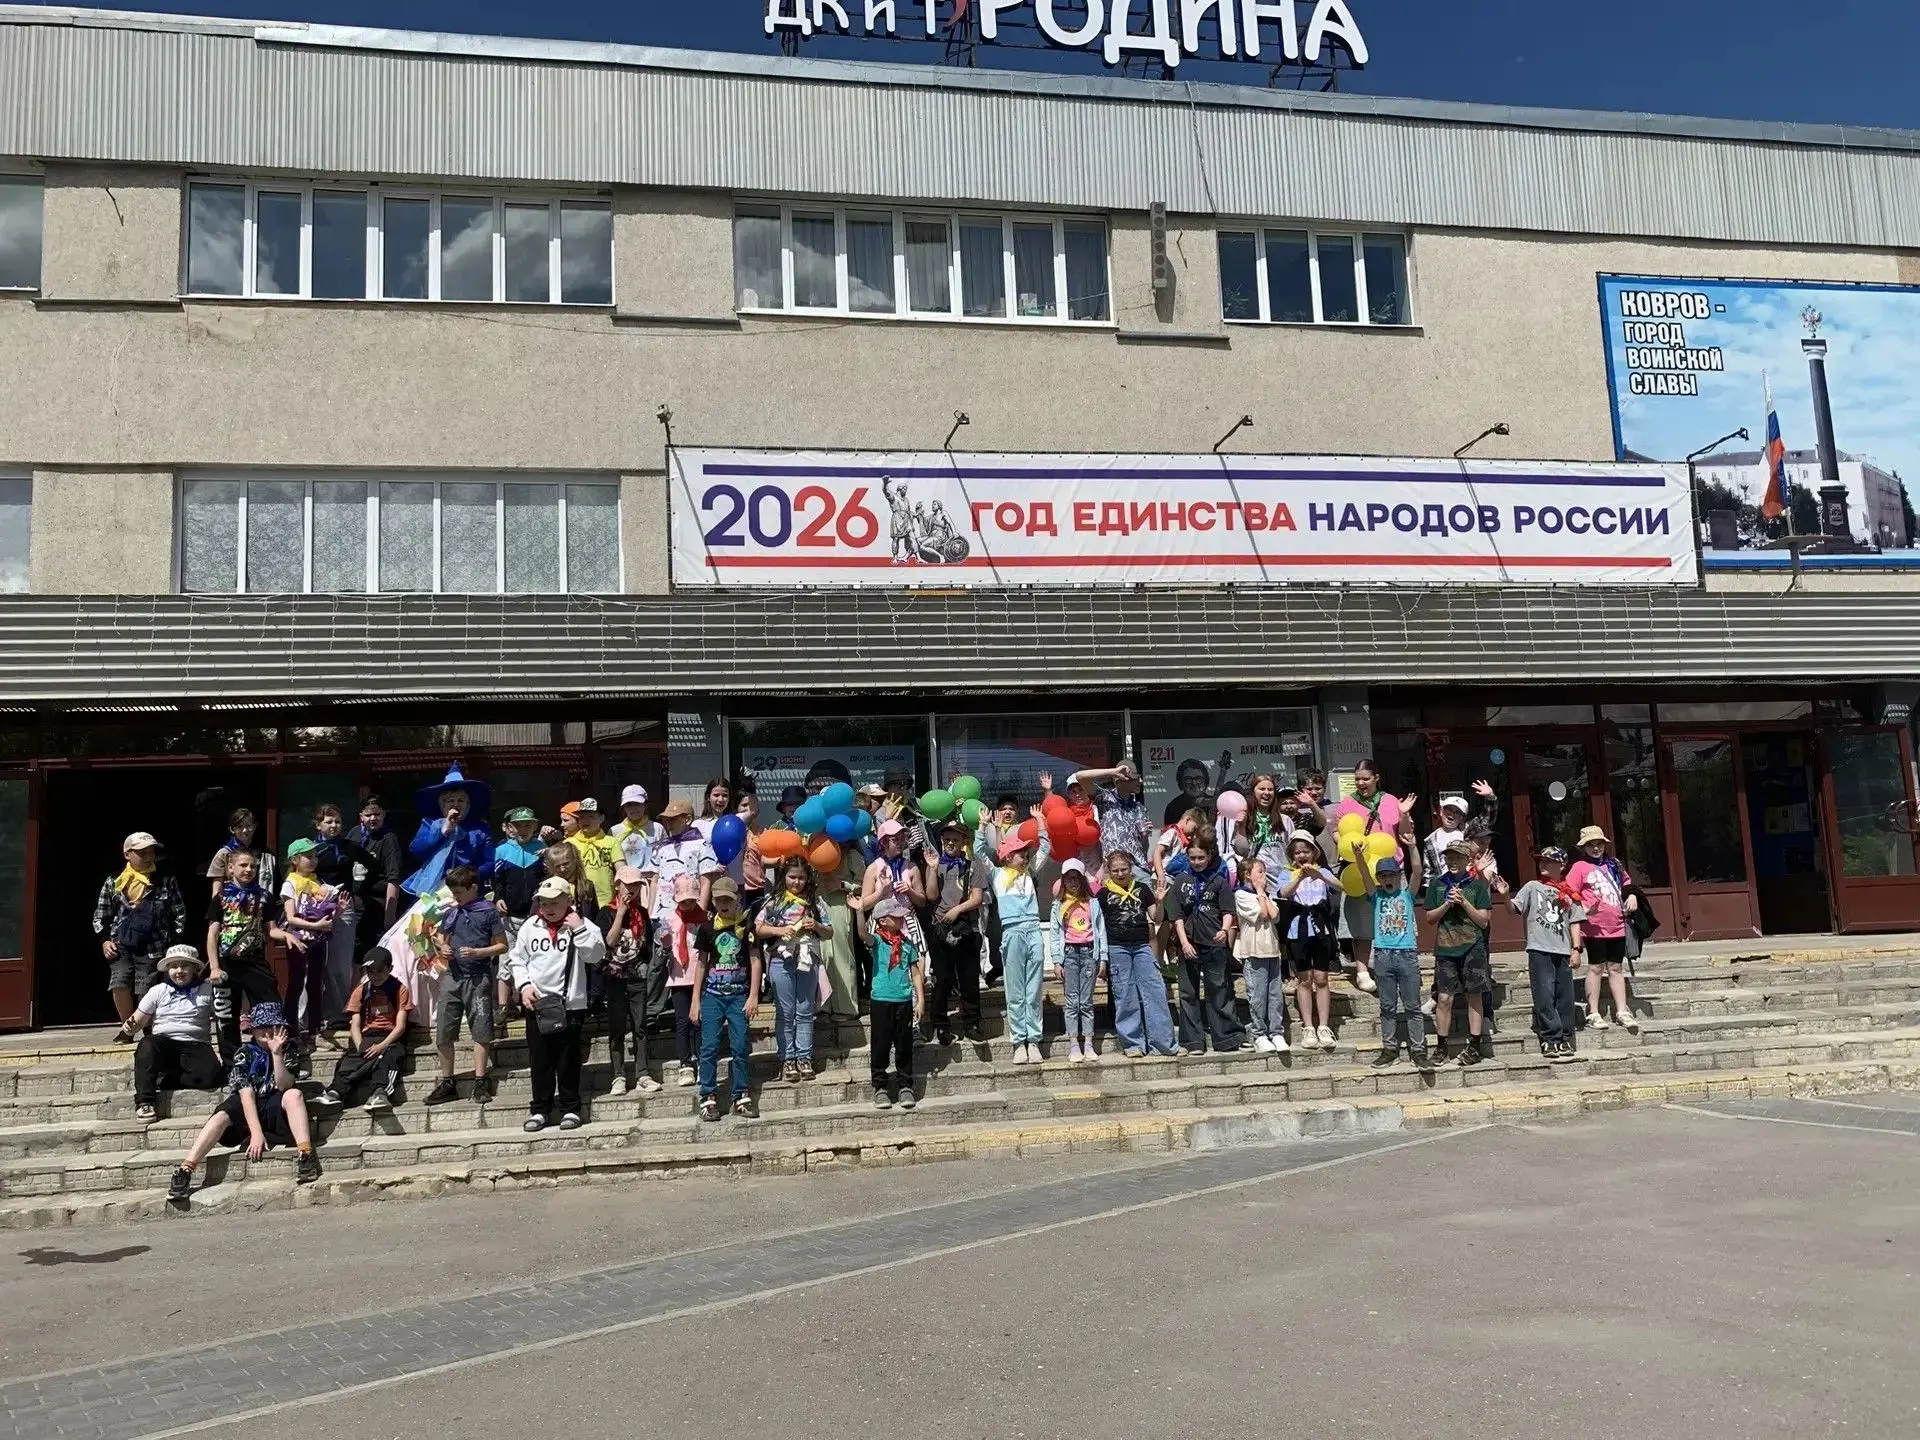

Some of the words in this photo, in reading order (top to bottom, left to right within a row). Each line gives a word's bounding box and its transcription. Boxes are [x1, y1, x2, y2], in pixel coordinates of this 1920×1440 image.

[1620, 290, 1711, 319] КОВРОВ
[1623, 321, 1685, 348] ГОРОД
[1626, 346, 1724, 371] ВОИНСКОЙ
[1629, 372, 1698, 396] СЛАВЫ
[702, 484, 879, 548] 2026
[972, 502, 1057, 536] ГОД
[1073, 502, 1297, 536] ЕДИНСТВА
[1309, 502, 1500, 537] НАРОДОВ
[1514, 504, 1669, 535] РОССИИ
[1149, 747, 1175, 761] 22.11
[1260, 744, 1283, 755] РОДИН
[753, 756, 777, 771] 29
